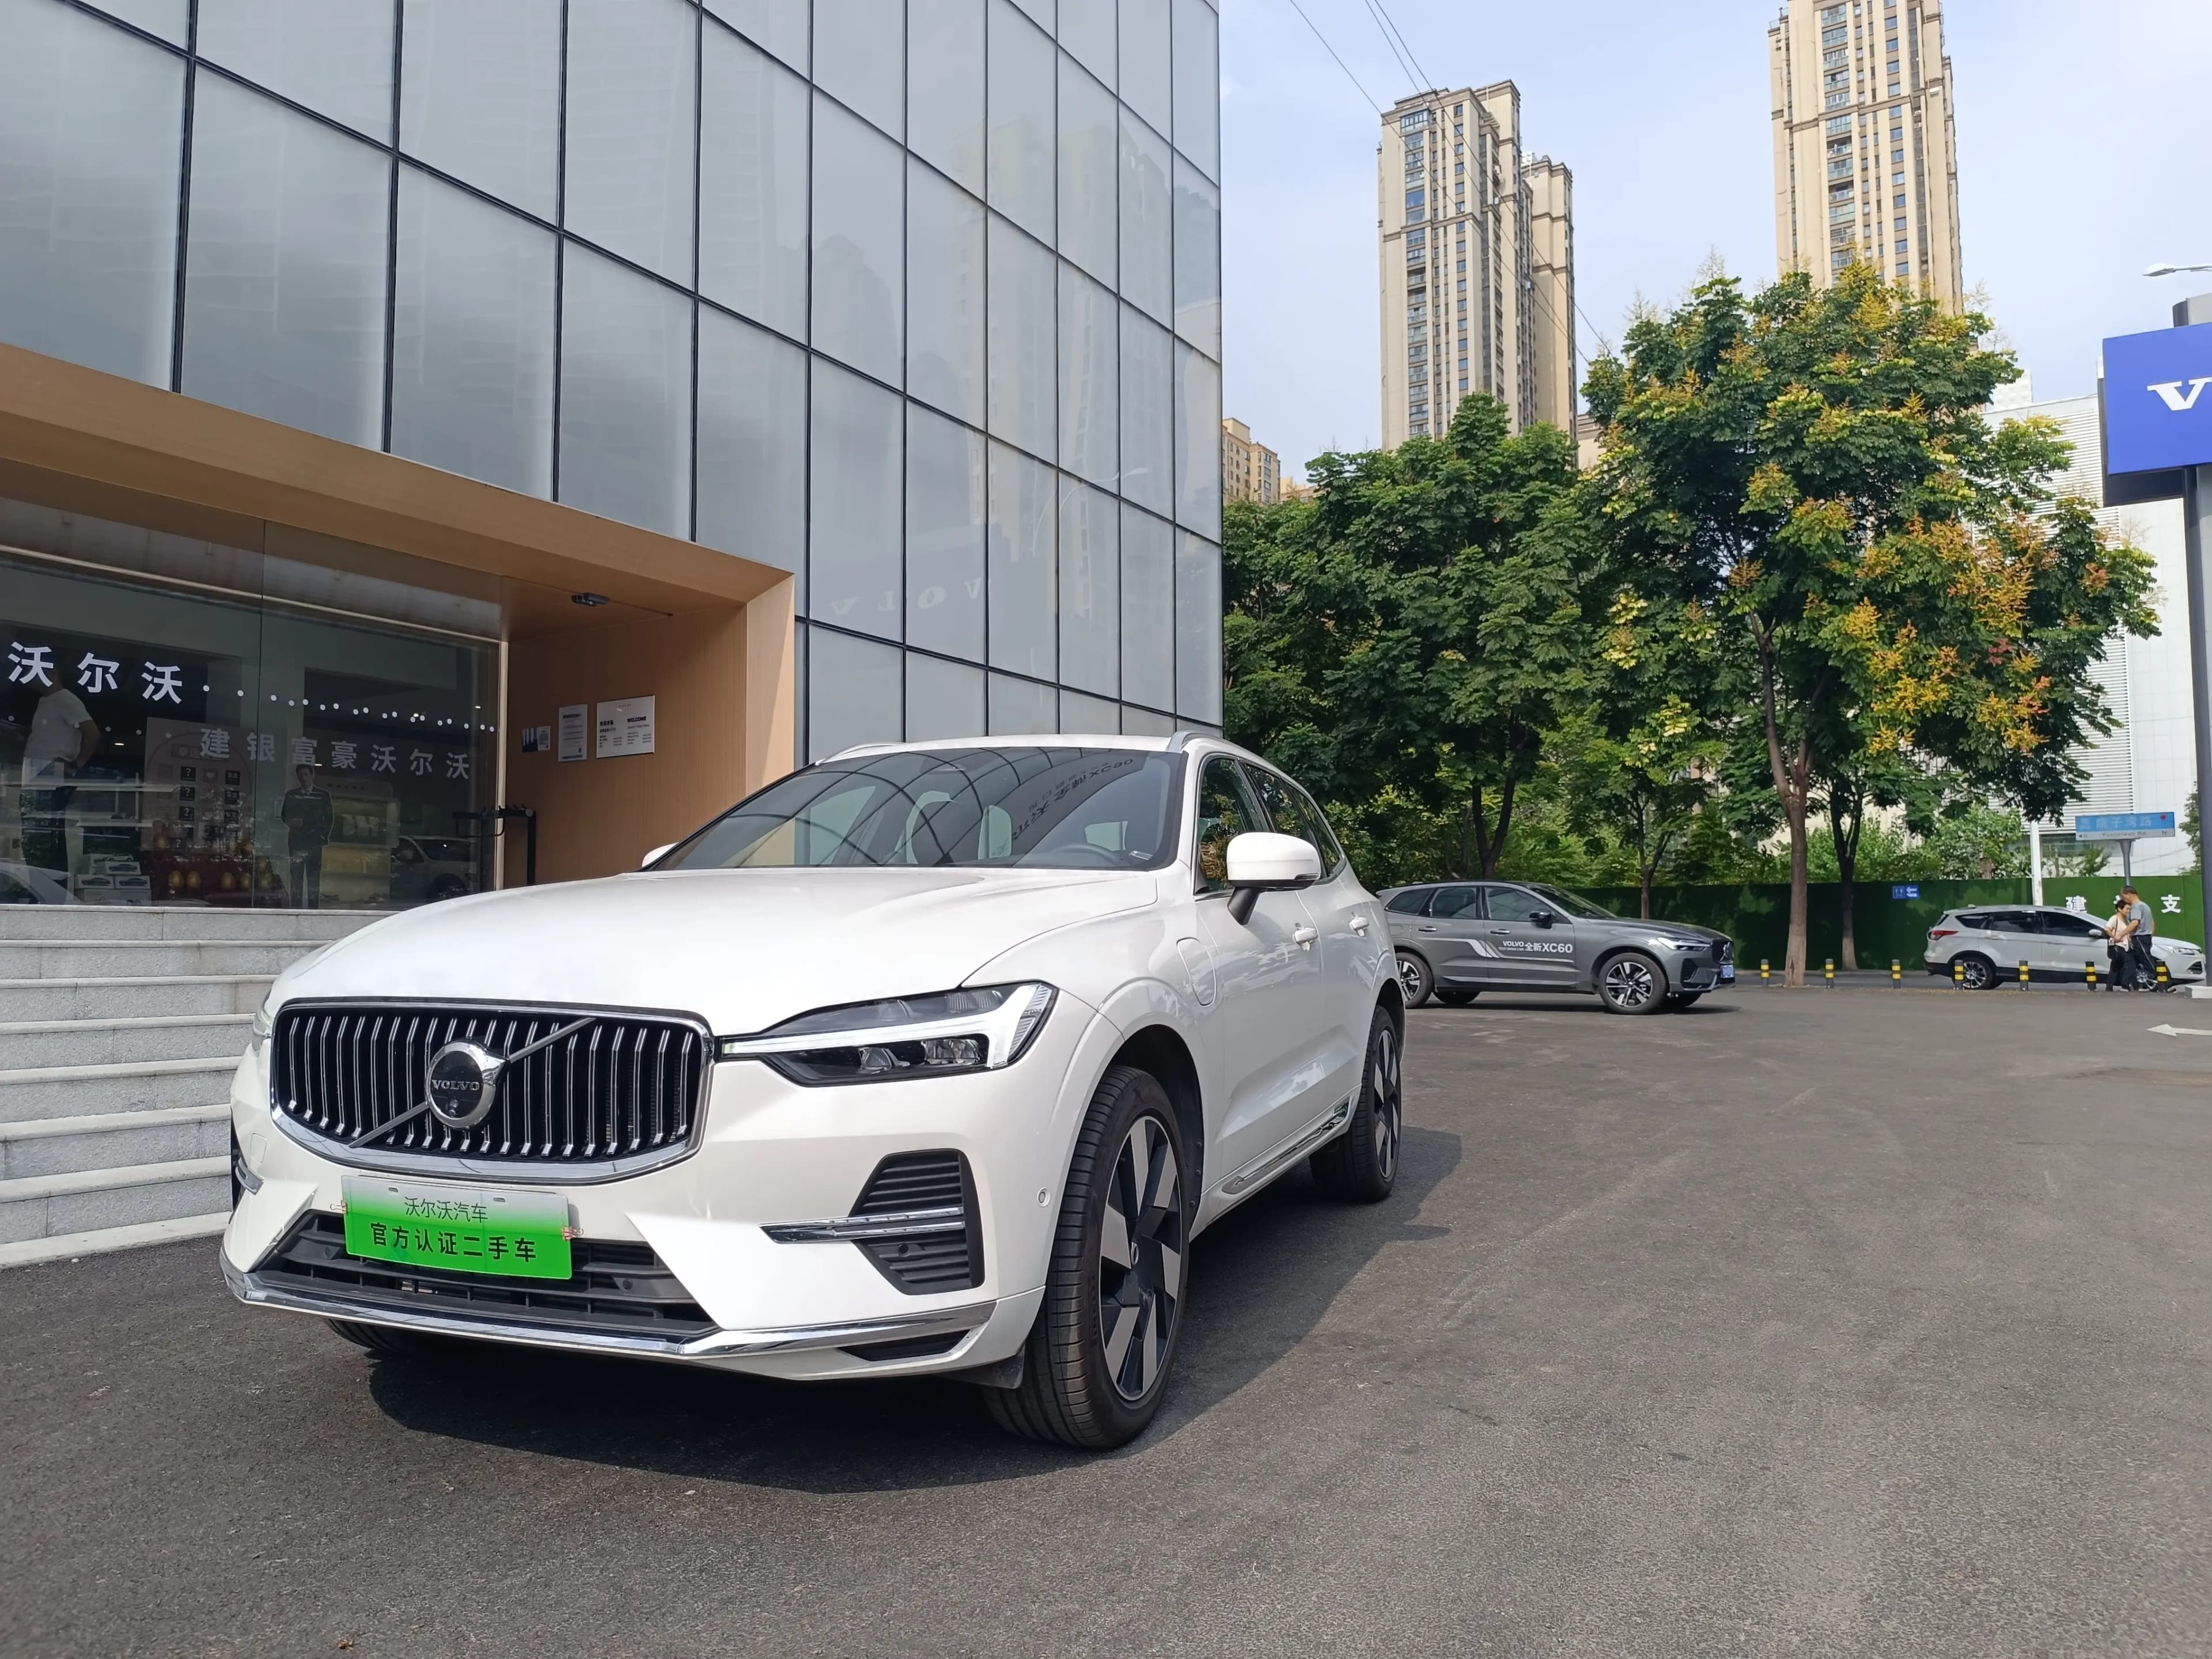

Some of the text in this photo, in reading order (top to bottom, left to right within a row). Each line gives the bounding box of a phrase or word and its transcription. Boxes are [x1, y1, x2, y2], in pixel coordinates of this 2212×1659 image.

[7, 641, 183, 704] 沃尔沃
[199, 728, 470, 779] 建银富豪沃尔沃
[1524, 942, 1573, 953] 全新XC60
[431, 1079, 480, 1091] VOLVO
[404, 1196, 488, 1224] 沃尔沃汽车
[370, 1222, 537, 1263] 官方认证二手车
